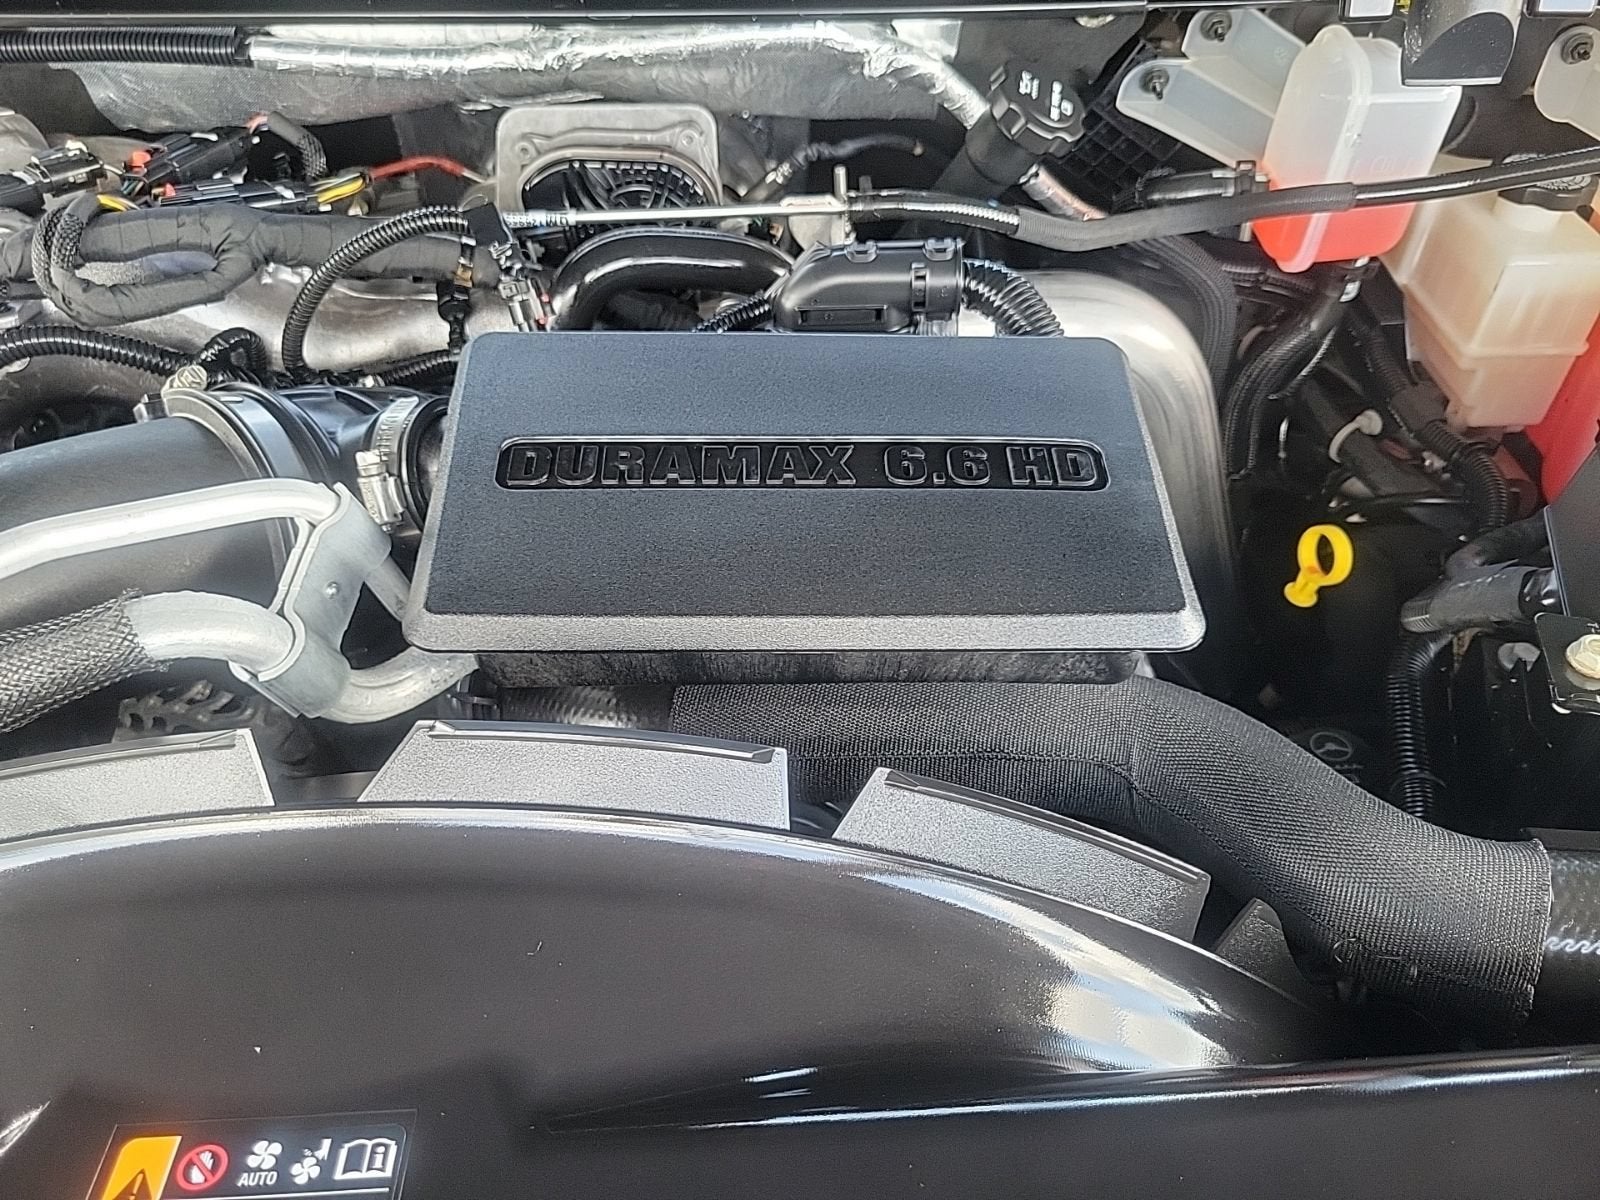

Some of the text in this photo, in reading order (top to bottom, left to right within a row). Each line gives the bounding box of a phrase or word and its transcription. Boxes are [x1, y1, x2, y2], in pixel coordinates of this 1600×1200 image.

[507, 444, 1097, 487] DURAMAX 6.6 HD
[236, 1171, 278, 1187] AUTO
